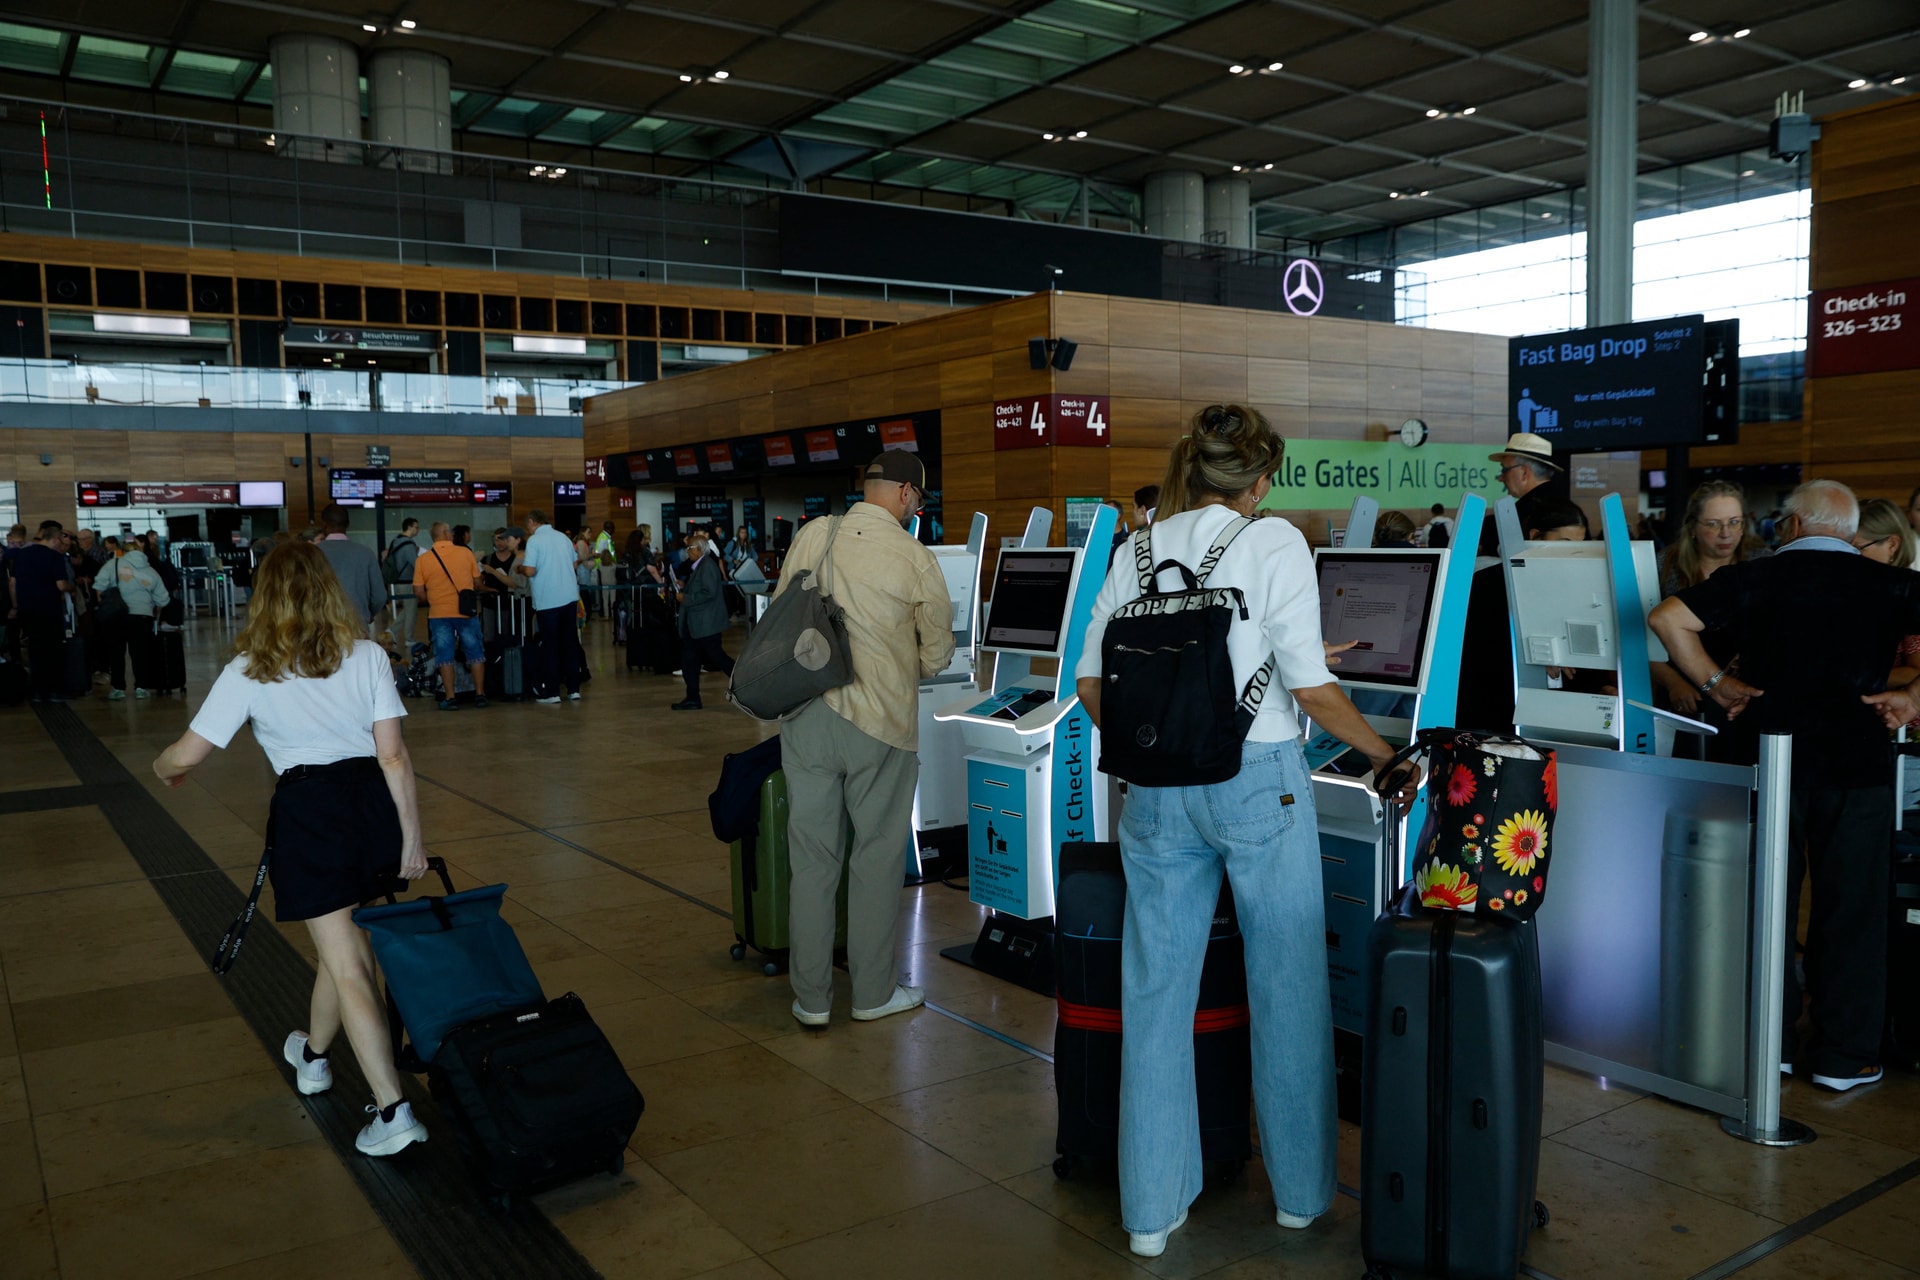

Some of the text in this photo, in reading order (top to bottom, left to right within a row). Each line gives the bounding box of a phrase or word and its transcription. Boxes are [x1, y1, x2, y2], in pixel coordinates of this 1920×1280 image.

[1823, 289, 1906, 315] Check-in
[1685, 327, 1692, 337] 2
[1519, 336, 1647, 367] Fast Bag Drop
[1673, 339, 1681, 350] 2
[996, 403, 1022, 416] Check-in
[1061, 400, 1085, 408] Check-in
[1030, 401, 1046, 437] 4
[1086, 401, 1106, 437] 4
[398, 471, 422, 480] Priority
[454, 471, 462, 484] 2
[598, 459, 606, 481] 4
[1316, 459, 1380, 488] Gates
[1400, 459, 1427, 488] All
[1434, 461, 1488, 489] Gates
[134, 487, 165, 496] Alle Gates
[1109, 598, 1168, 619] OOP!
[1064, 716, 1084, 821] Check-in
